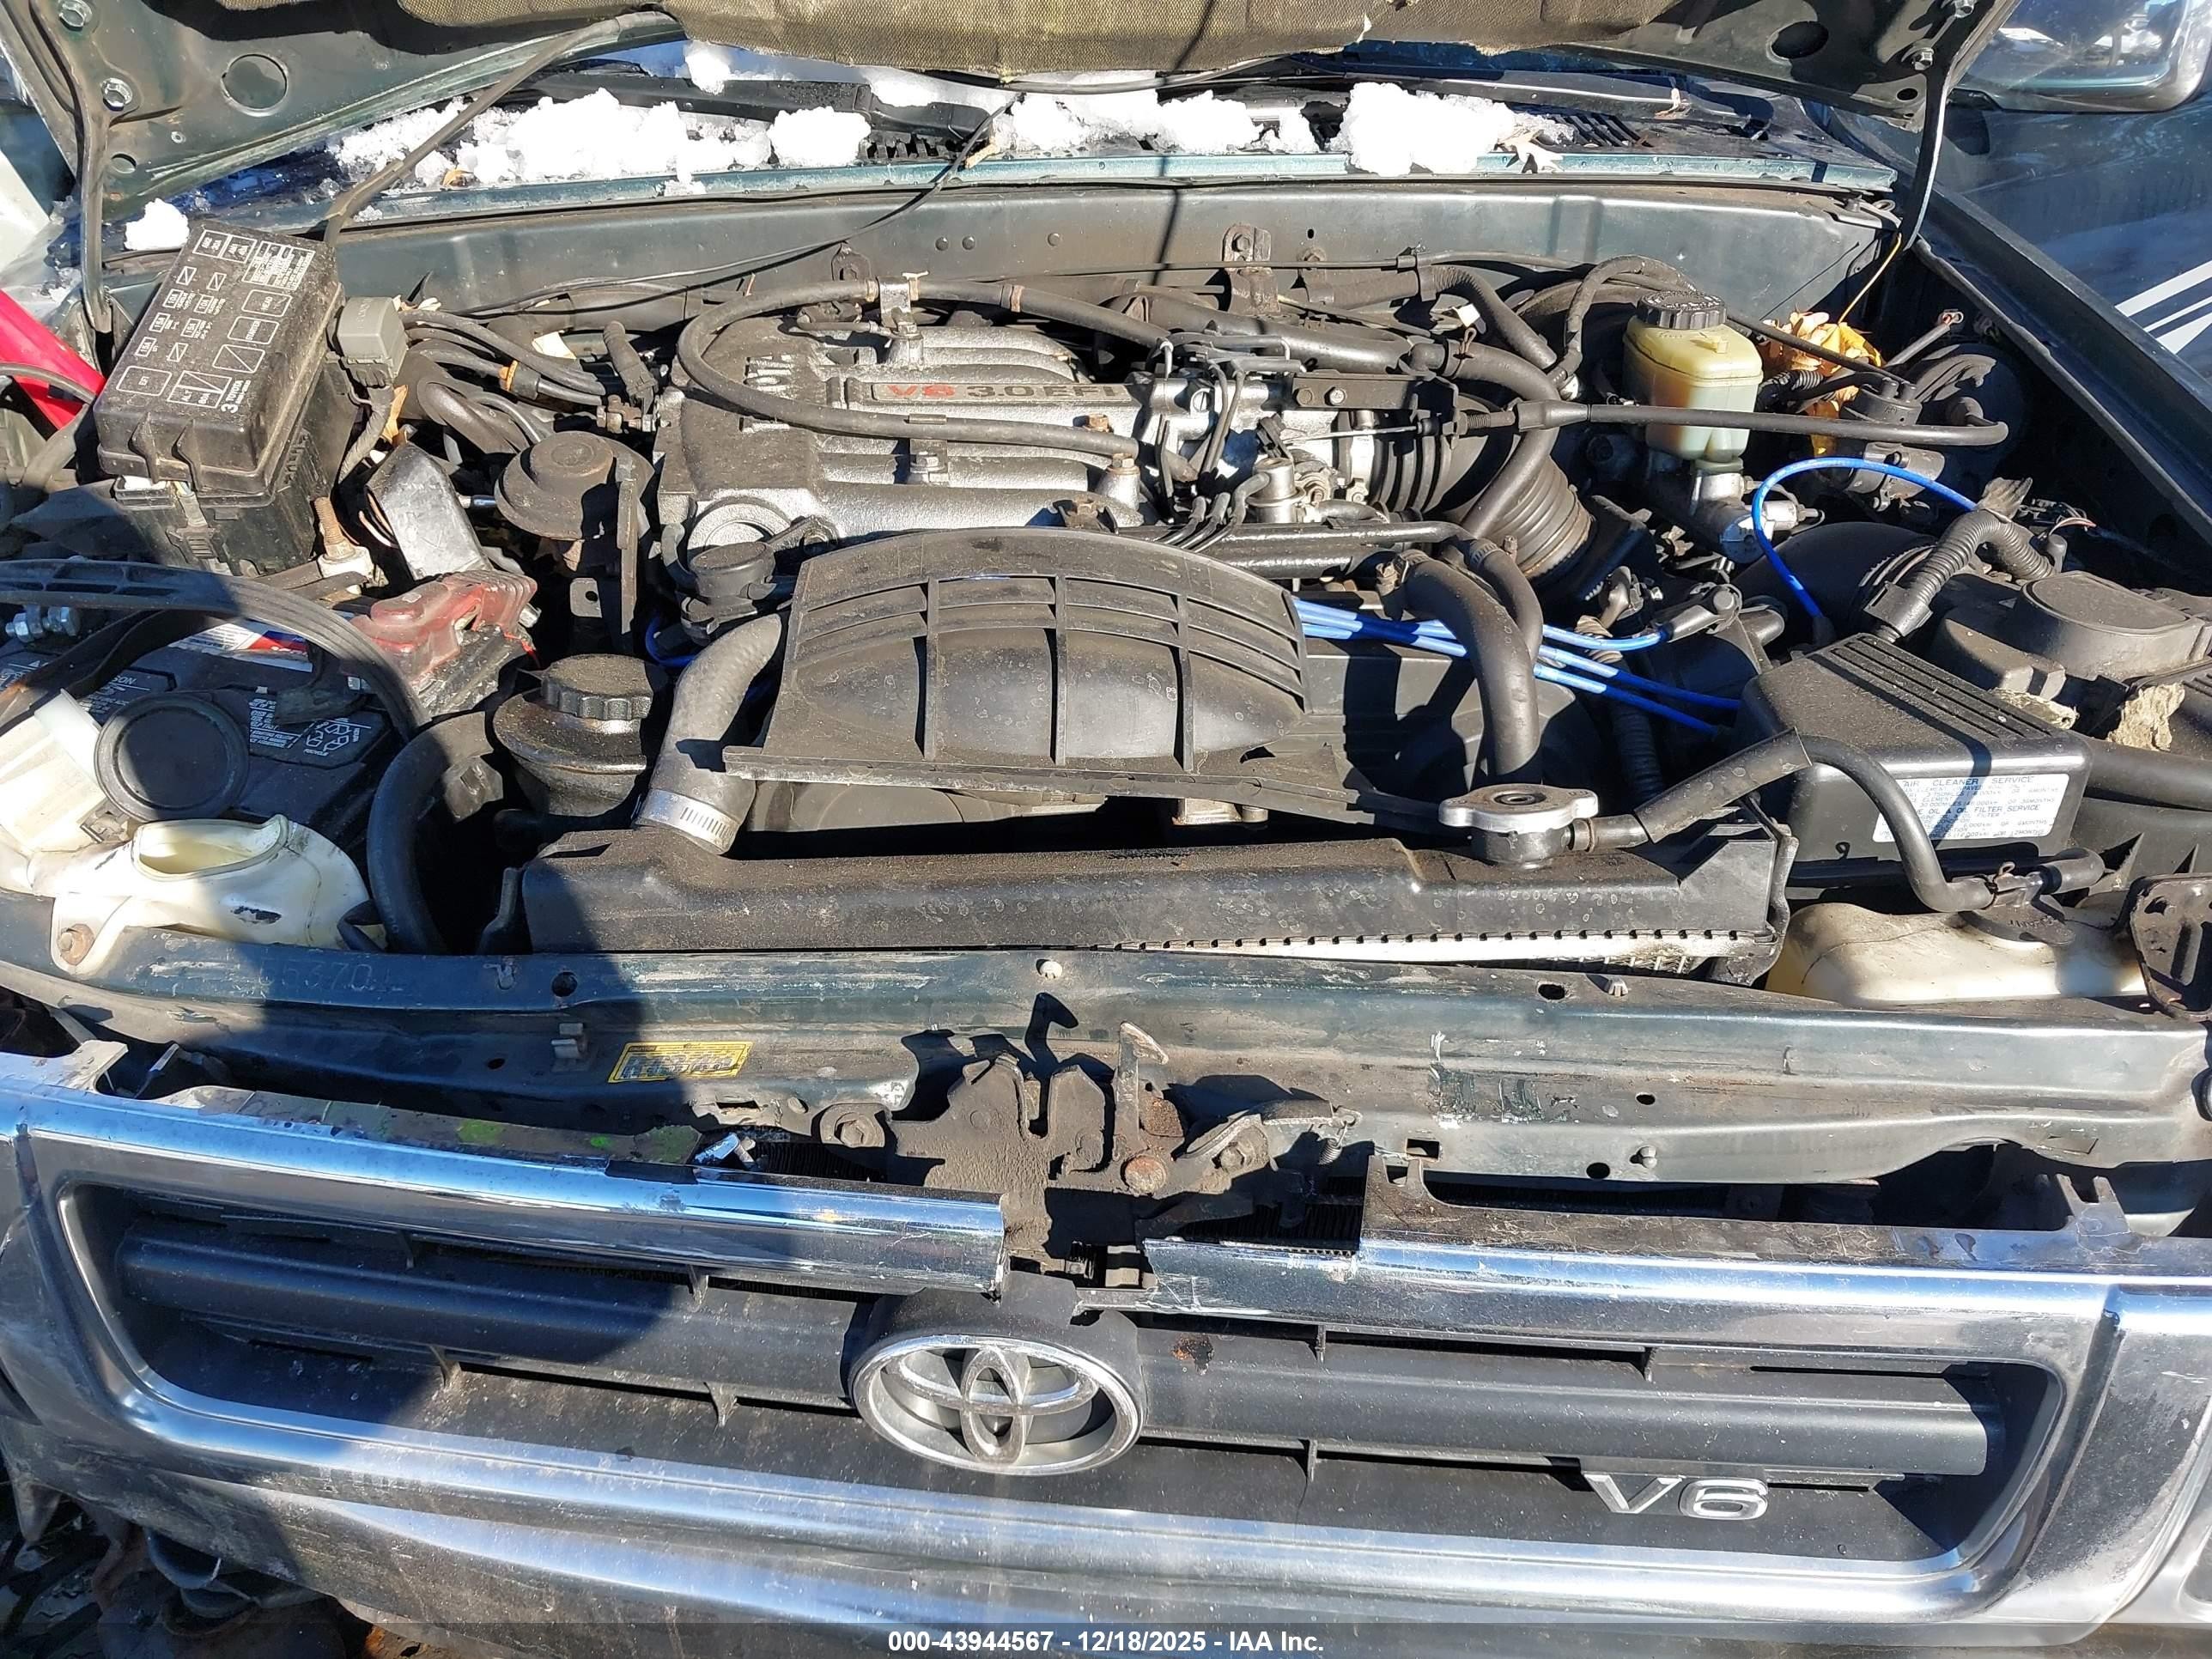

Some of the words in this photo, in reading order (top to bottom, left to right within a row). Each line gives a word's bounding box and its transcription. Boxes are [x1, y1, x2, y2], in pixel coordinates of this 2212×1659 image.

[198, 299, 210, 309] 10A
[154, 316, 166, 328] 15A
[185, 323, 197, 333] 15A
[140, 342, 152, 352] 15A
[138, 376, 149, 386] EFI
[180, 389, 194, 402] ALT
[226, 380, 244, 403] TOYOTA
[886, 384, 956, 398] V6
[966, 385, 1035, 398] 3.0
[1043, 386, 1117, 398] EFI
[221, 403, 239, 413] 3
[1991, 775, 2035, 784] SERVICE
[2006, 804, 2041, 812] SERVICE
[1583, 1474, 1769, 1520] V6
